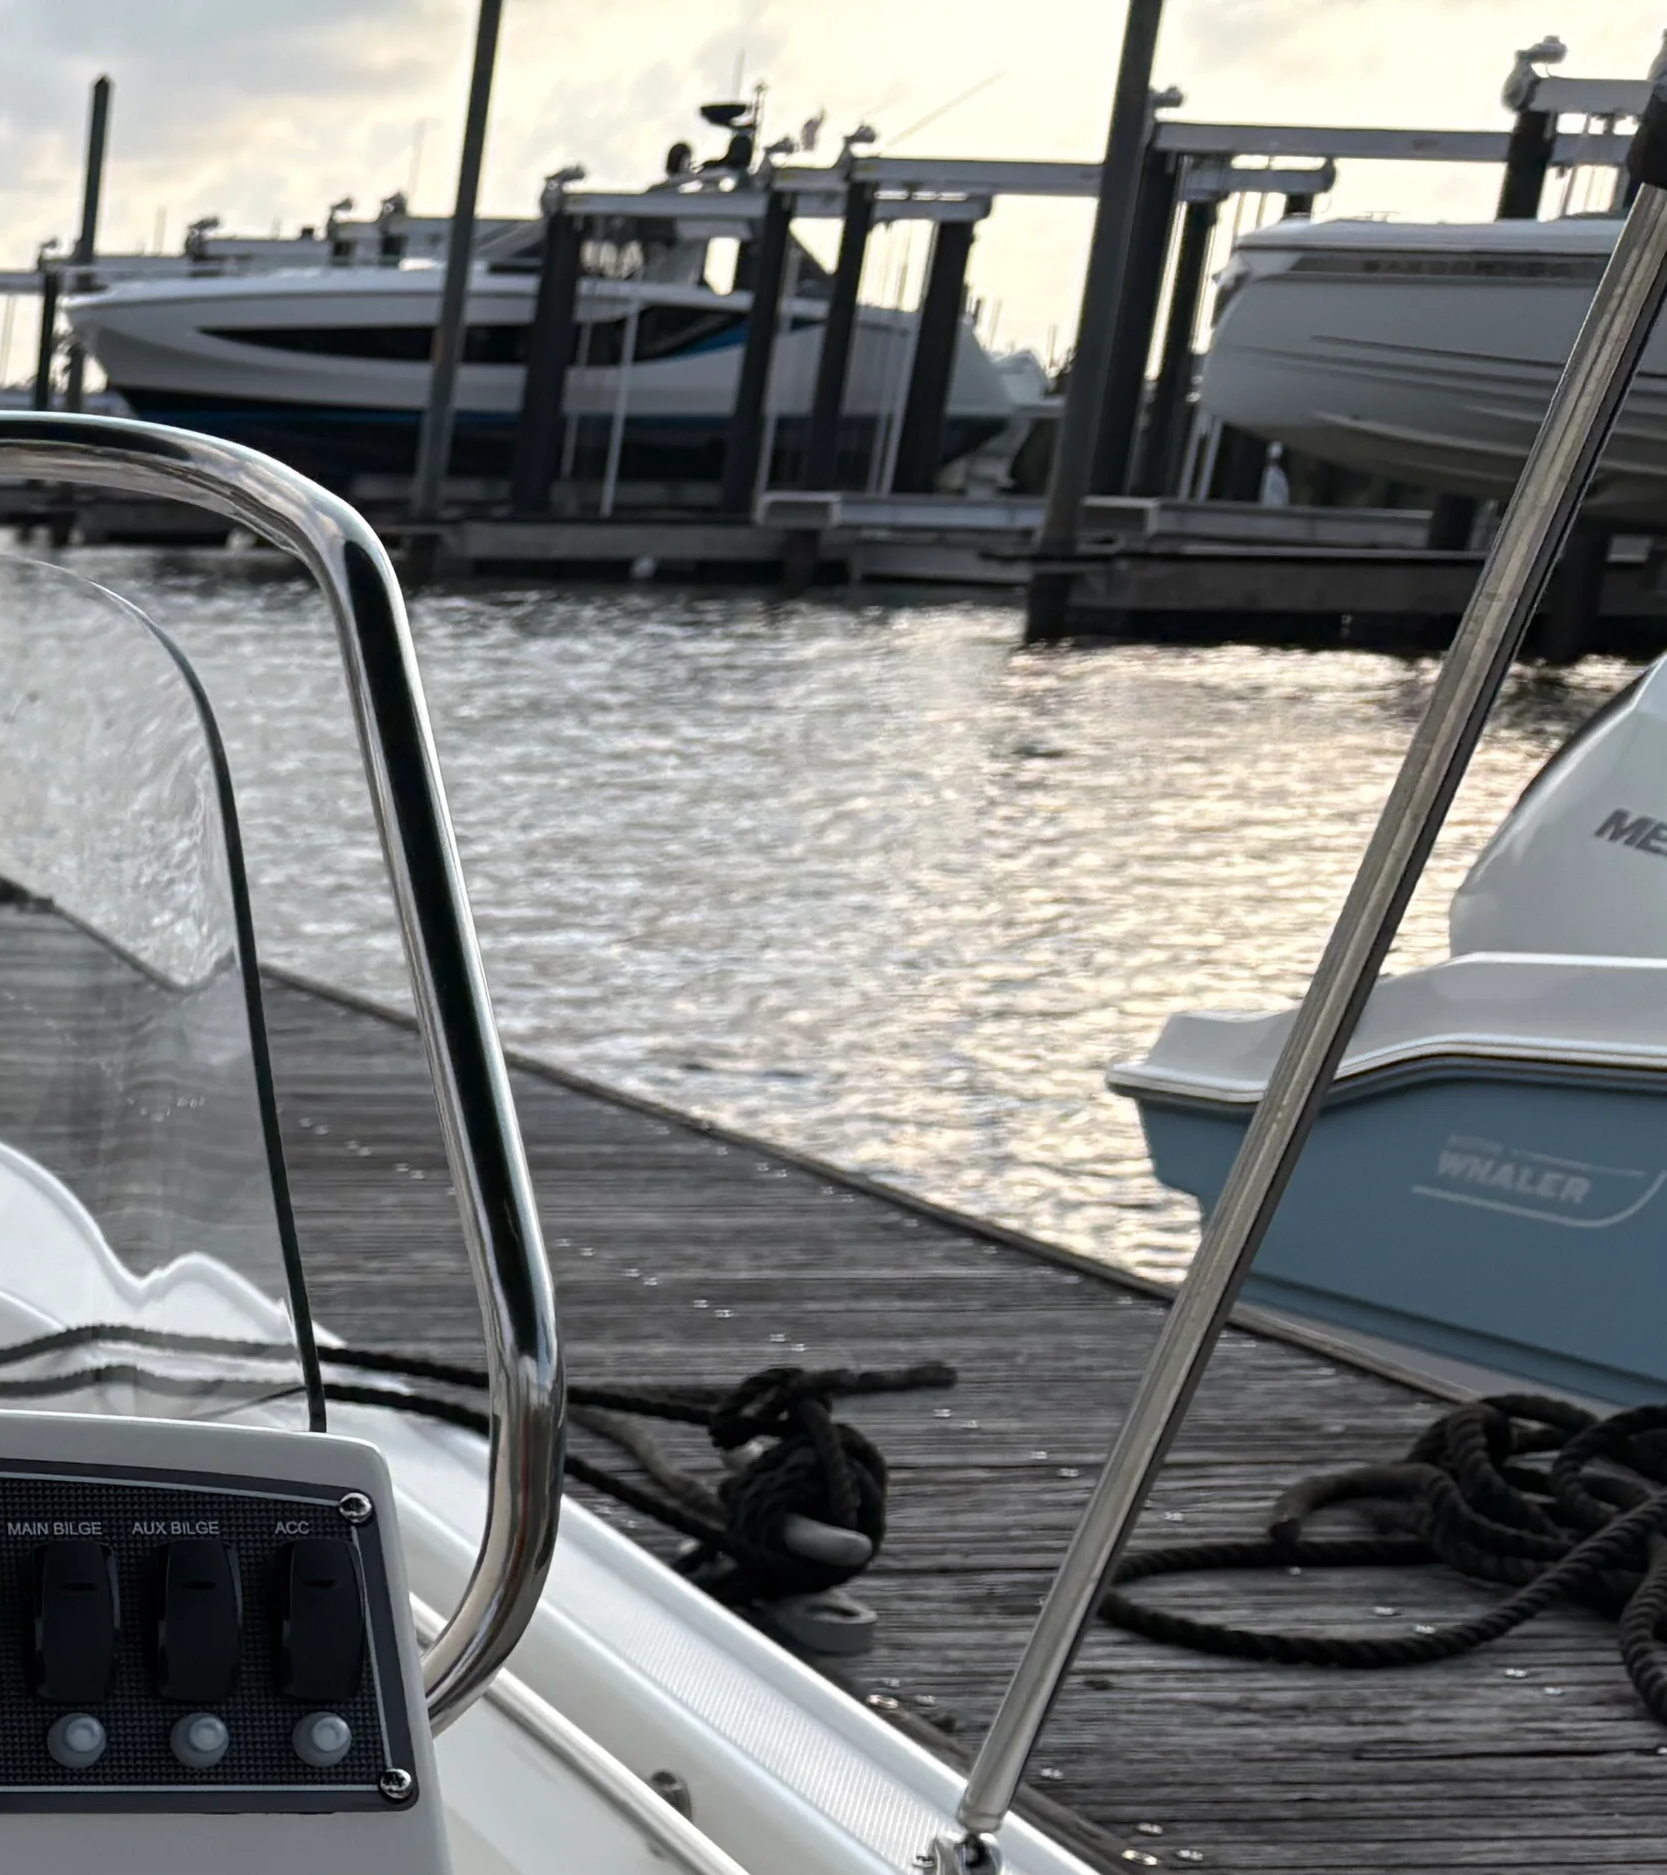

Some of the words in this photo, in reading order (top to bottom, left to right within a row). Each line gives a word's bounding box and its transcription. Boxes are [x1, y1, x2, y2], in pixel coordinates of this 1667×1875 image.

[1437, 1150, 1591, 1204] WHALER
[7, 1522, 49, 1536] MAIN
[54, 1522, 103, 1536] BILGE
[131, 1521, 166, 1536] AUX
[171, 1521, 220, 1536] BILGE
[274, 1521, 310, 1535] ACC
